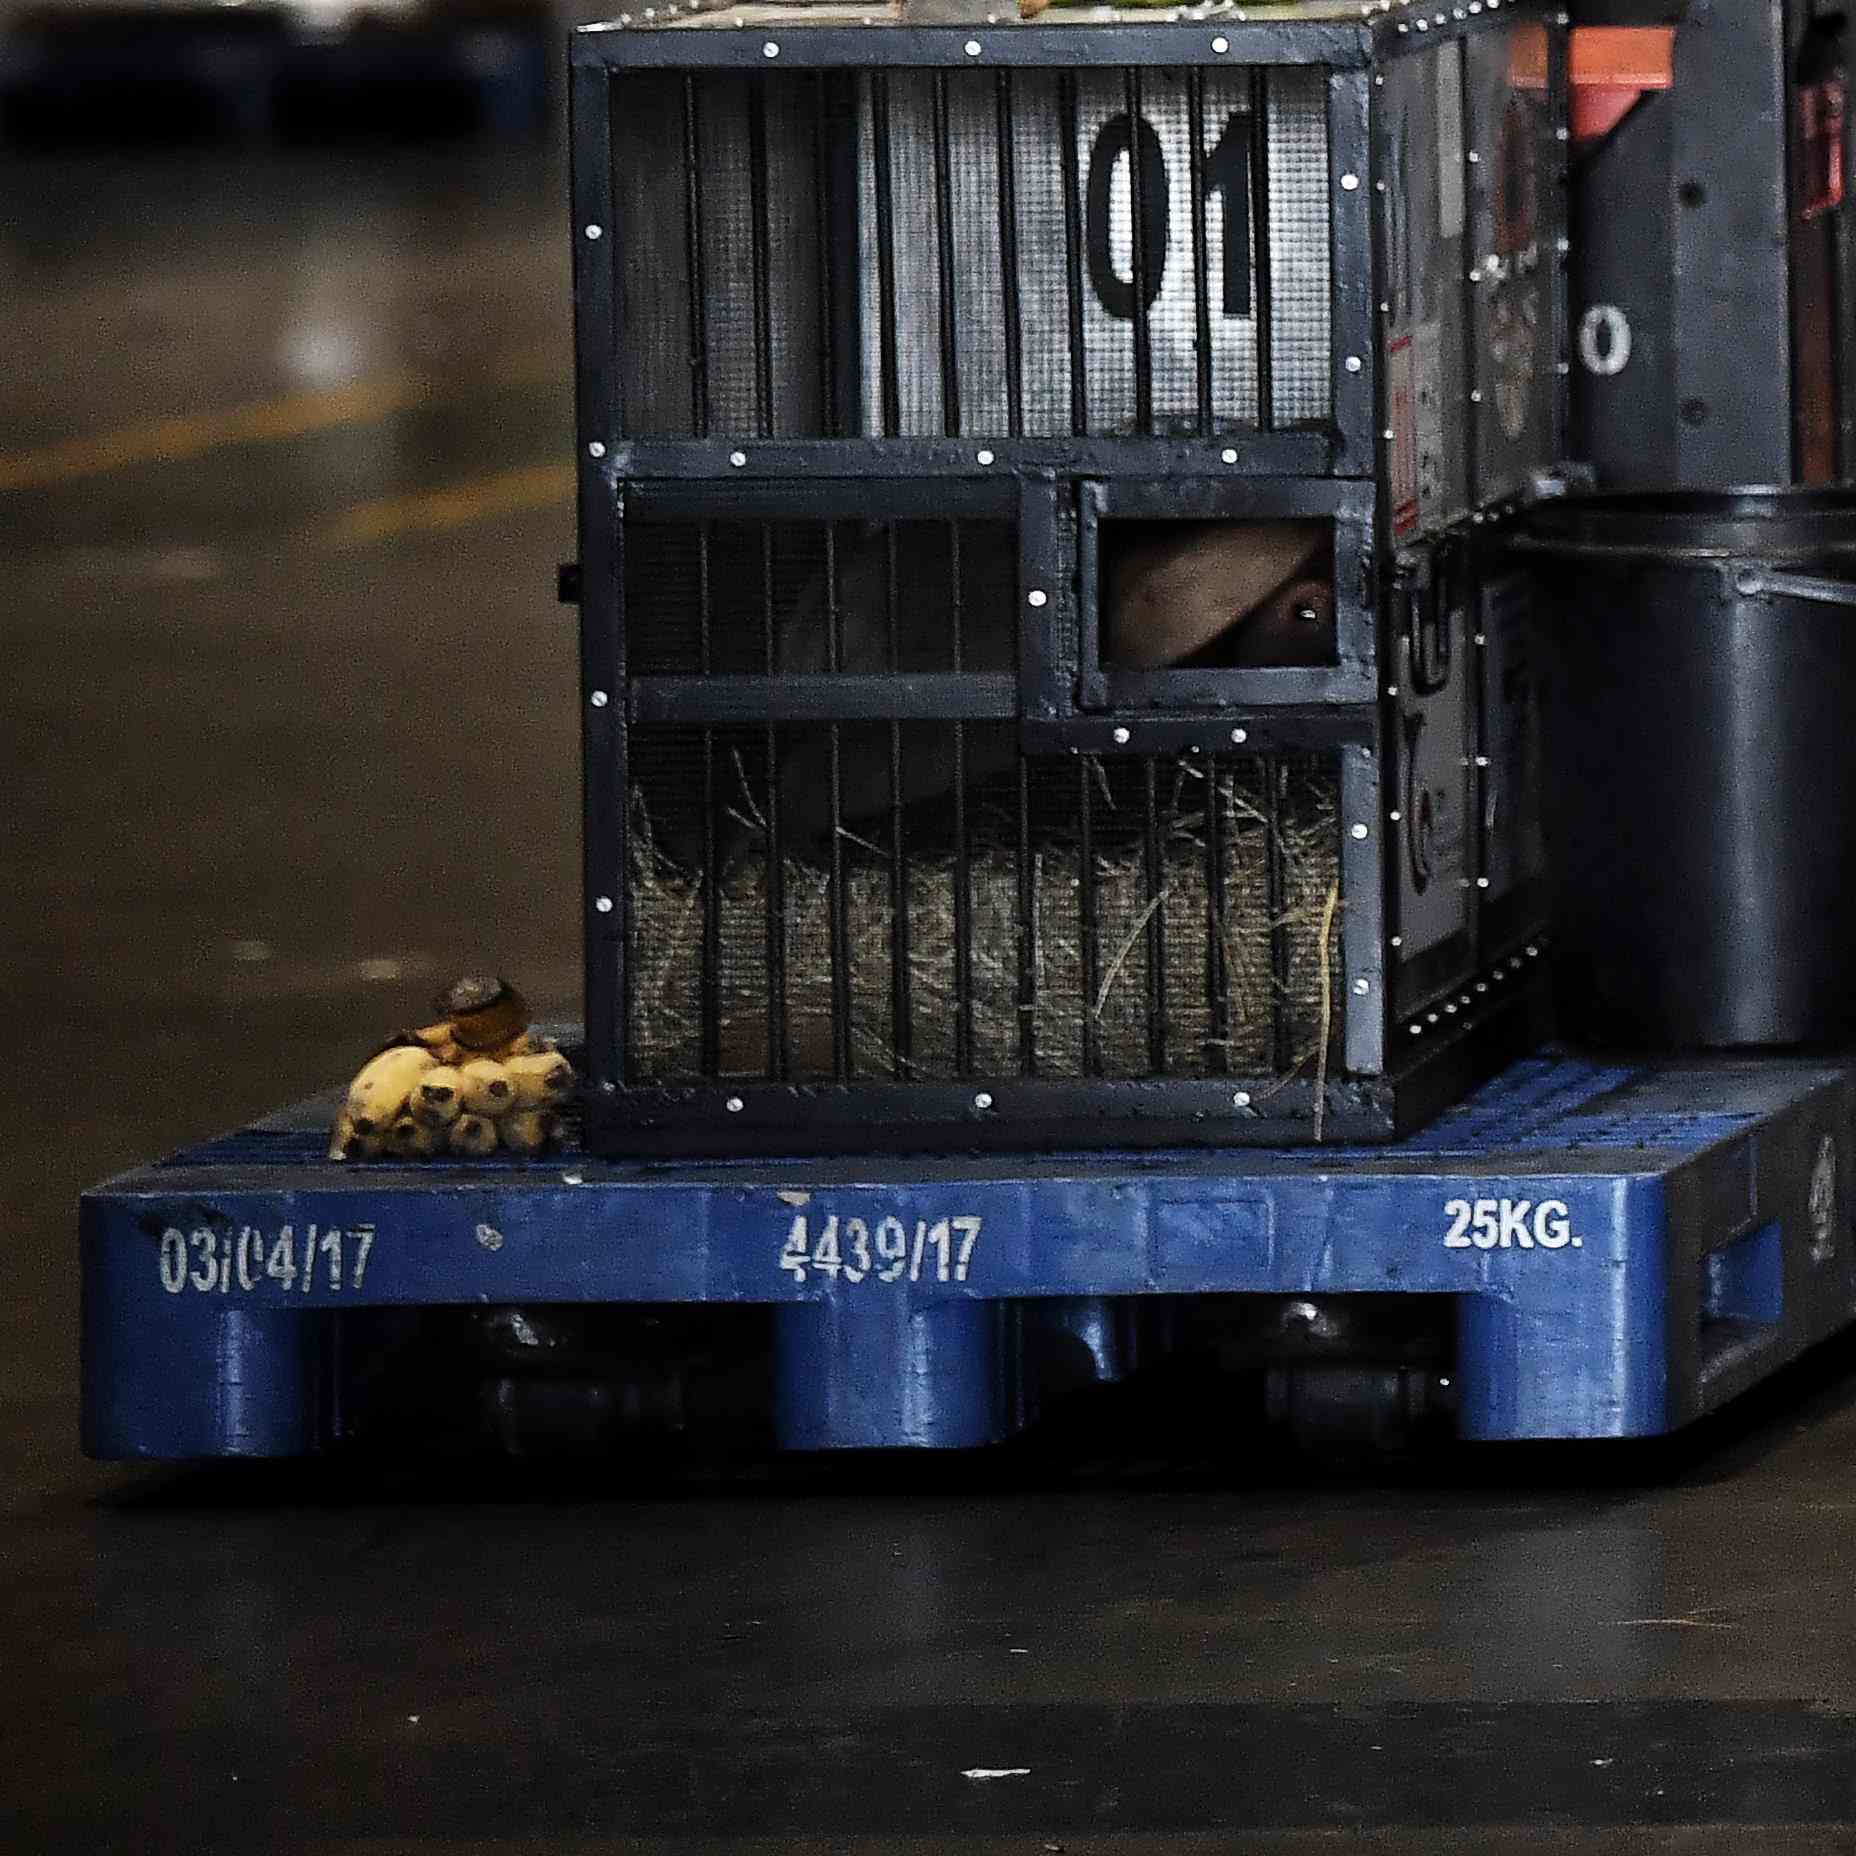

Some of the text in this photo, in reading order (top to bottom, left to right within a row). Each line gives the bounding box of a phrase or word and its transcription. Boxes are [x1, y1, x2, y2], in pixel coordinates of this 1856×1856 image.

[1087, 110, 1254, 320] 01
[159, 1224, 376, 1293] 03/04/17
[780, 1214, 982, 1284] 4439/17
[1443, 1199, 1583, 1250] 25KG.
